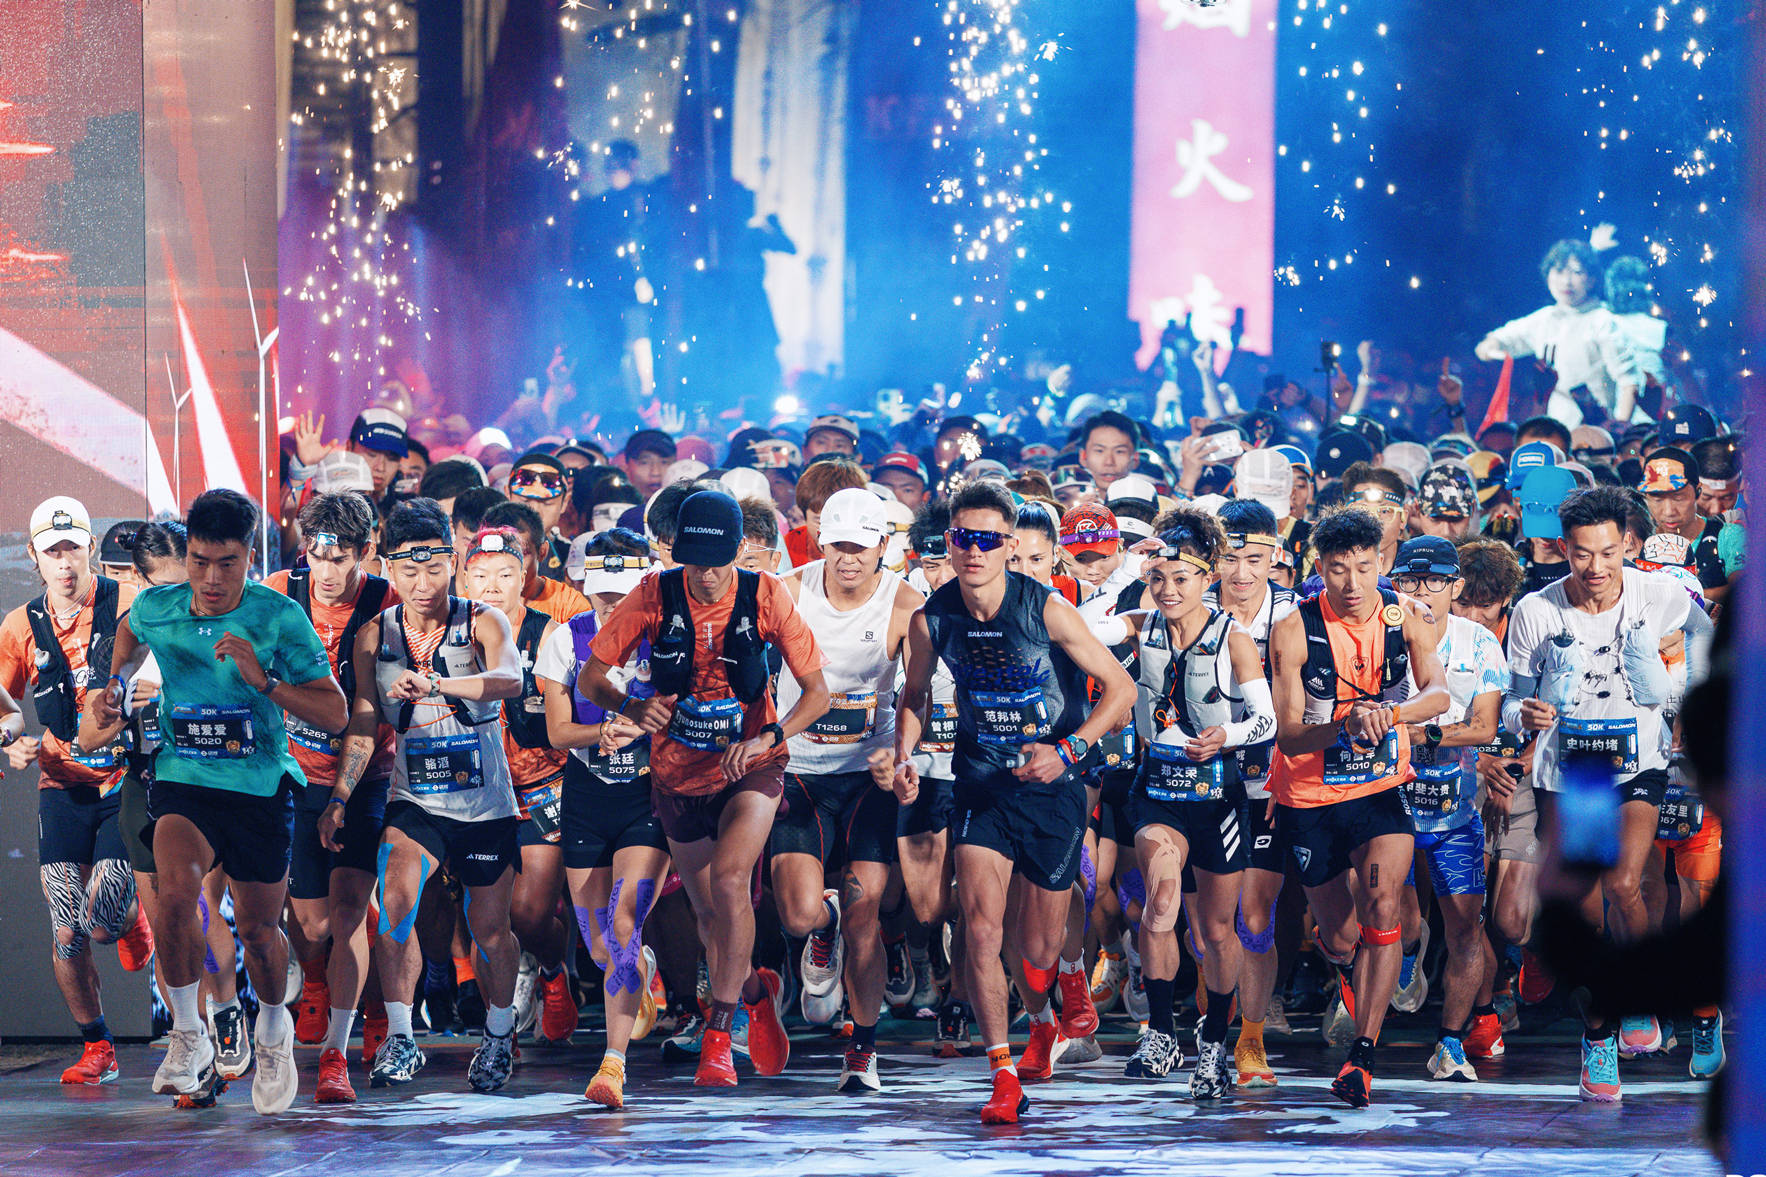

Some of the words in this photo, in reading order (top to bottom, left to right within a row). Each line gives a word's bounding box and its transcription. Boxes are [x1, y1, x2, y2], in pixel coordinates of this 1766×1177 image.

[684, 526, 724, 535] SALOMON
[984, 710, 1022, 722] 范邦林
[816, 723, 847, 732] T1268
[931, 720, 958, 732] 曾根
[992, 724, 1017, 732] 5001
[302, 727, 328, 740] 5265
[685, 730, 712, 739] 5007
[936, 732, 957, 740] T10
[194, 737, 222, 745] 5020
[608, 766, 635, 774] 5075
[1345, 761, 1370, 771] 5010
[425, 770, 451, 779] 5005
[1424, 769, 1441, 777] 50K
[1166, 779, 1192, 788] 5072
[1414, 796, 1439, 805] 5016
[1661, 803, 1688, 818] 友里
[474, 853, 499, 861] TERREX
